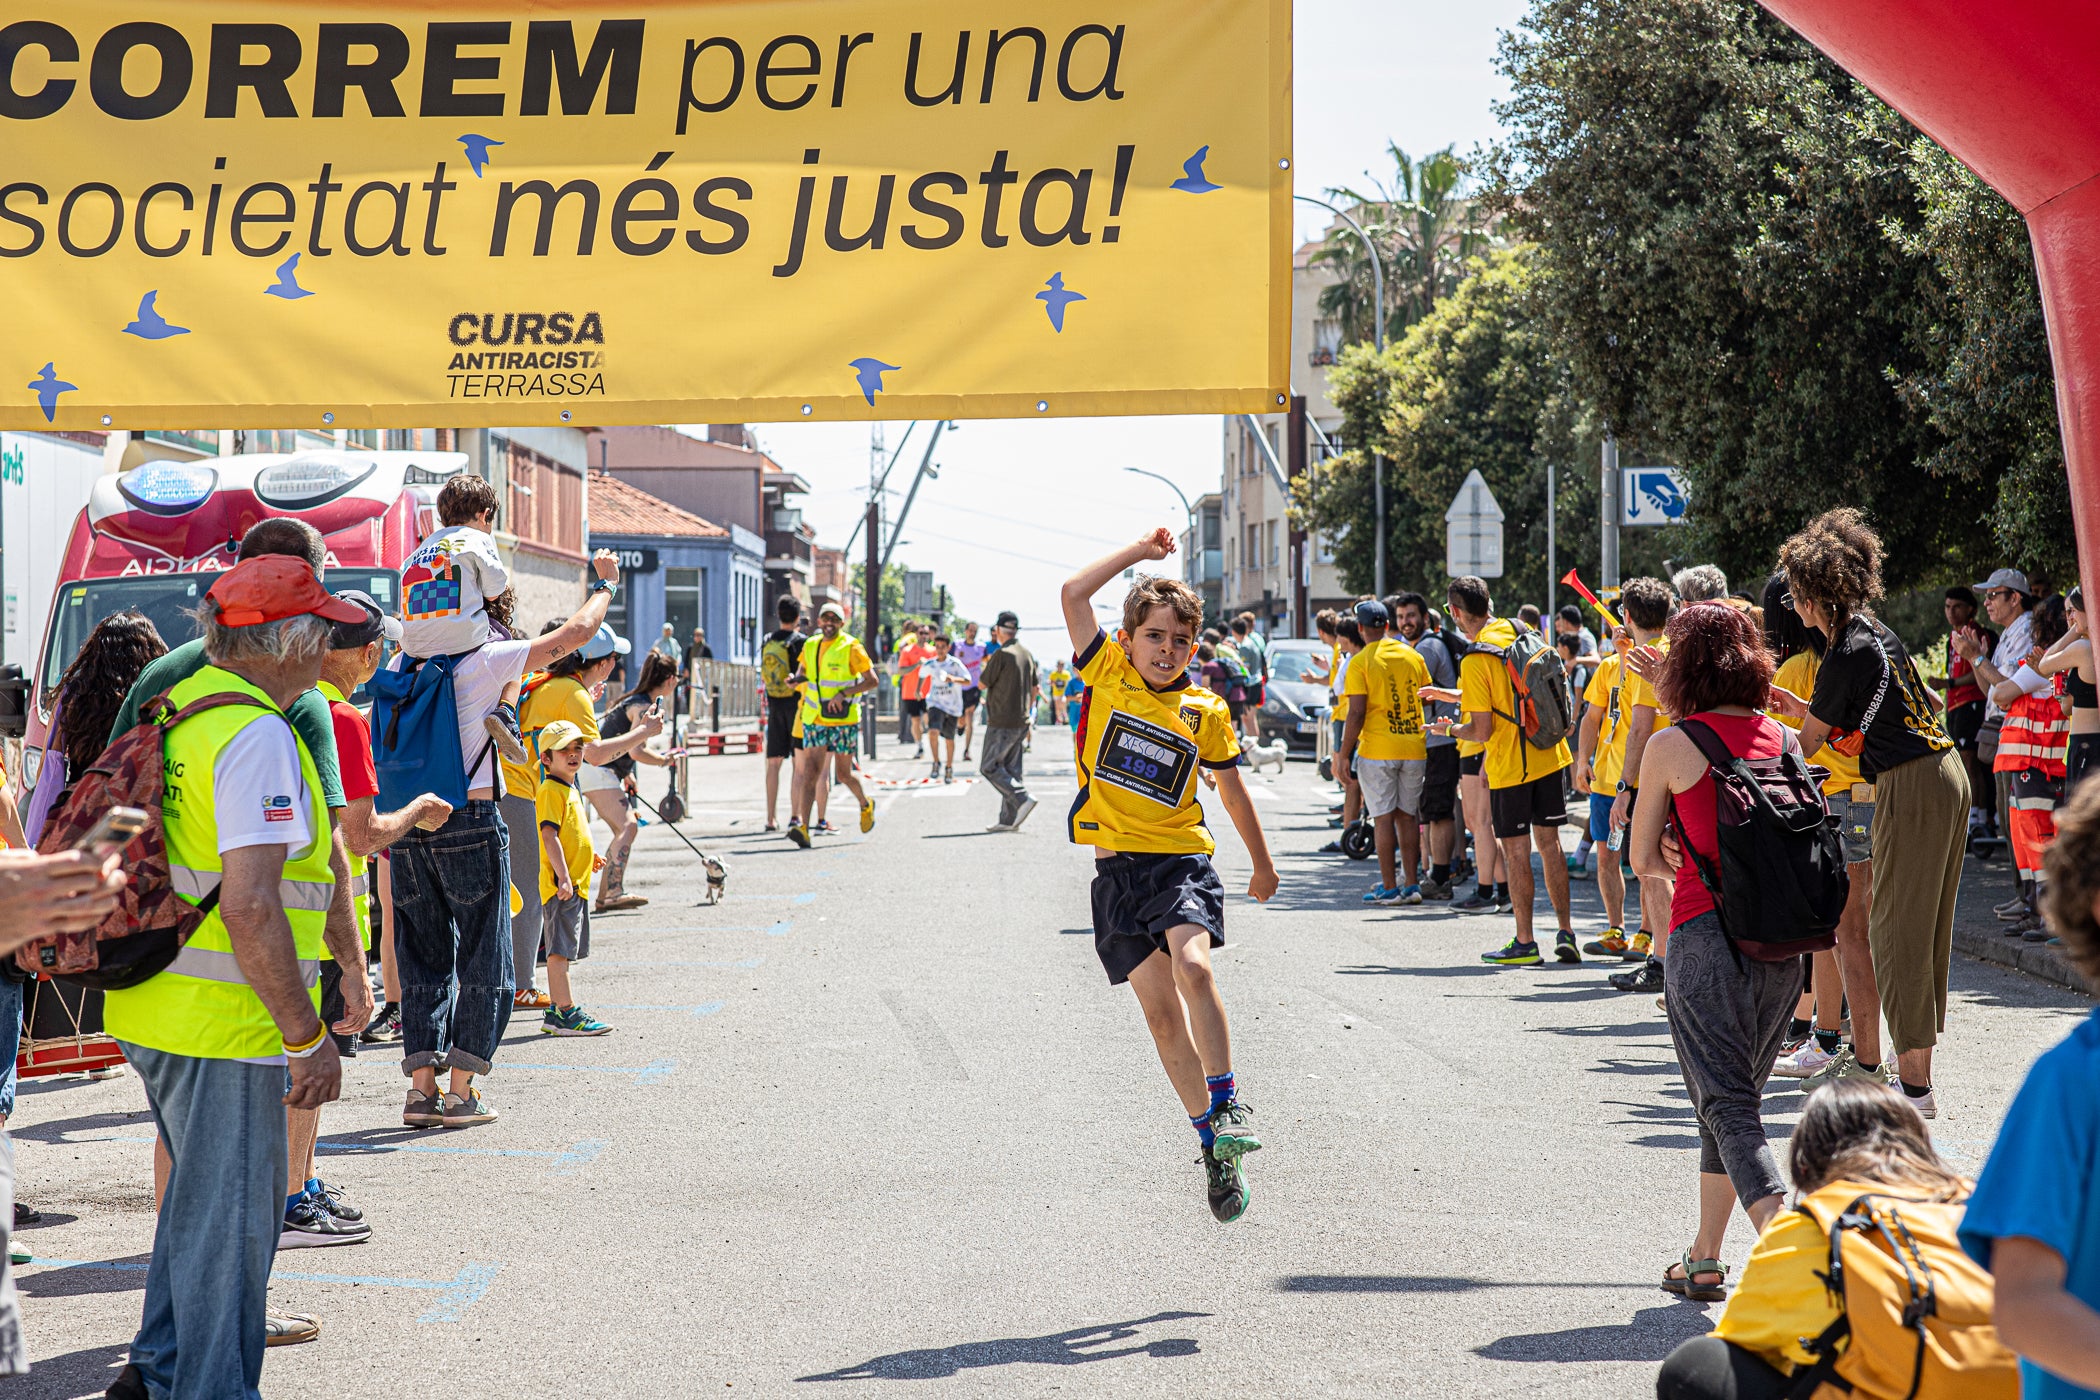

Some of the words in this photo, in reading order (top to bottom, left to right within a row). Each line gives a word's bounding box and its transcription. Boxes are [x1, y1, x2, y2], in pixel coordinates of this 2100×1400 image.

[0, 19, 646, 121] CORREM
[675, 32, 874, 135] per
[904, 23, 1126, 107] una
[0, 156, 457, 258] societat
[488, 150, 753, 257] més
[772, 144, 1136, 278] justa!
[448, 311, 605, 347] CURSA
[448, 351, 606, 370] ANTIRACISTA
[446, 373, 606, 398] TERRASSA
[1127, 719, 1146, 731] CURSA
[1145, 727, 1175, 742] ANTIRACIST
[1120, 755, 1159, 780] 199
[1106, 772, 1125, 783] CURSA
[1124, 780, 1155, 795] ANTIRACIST
